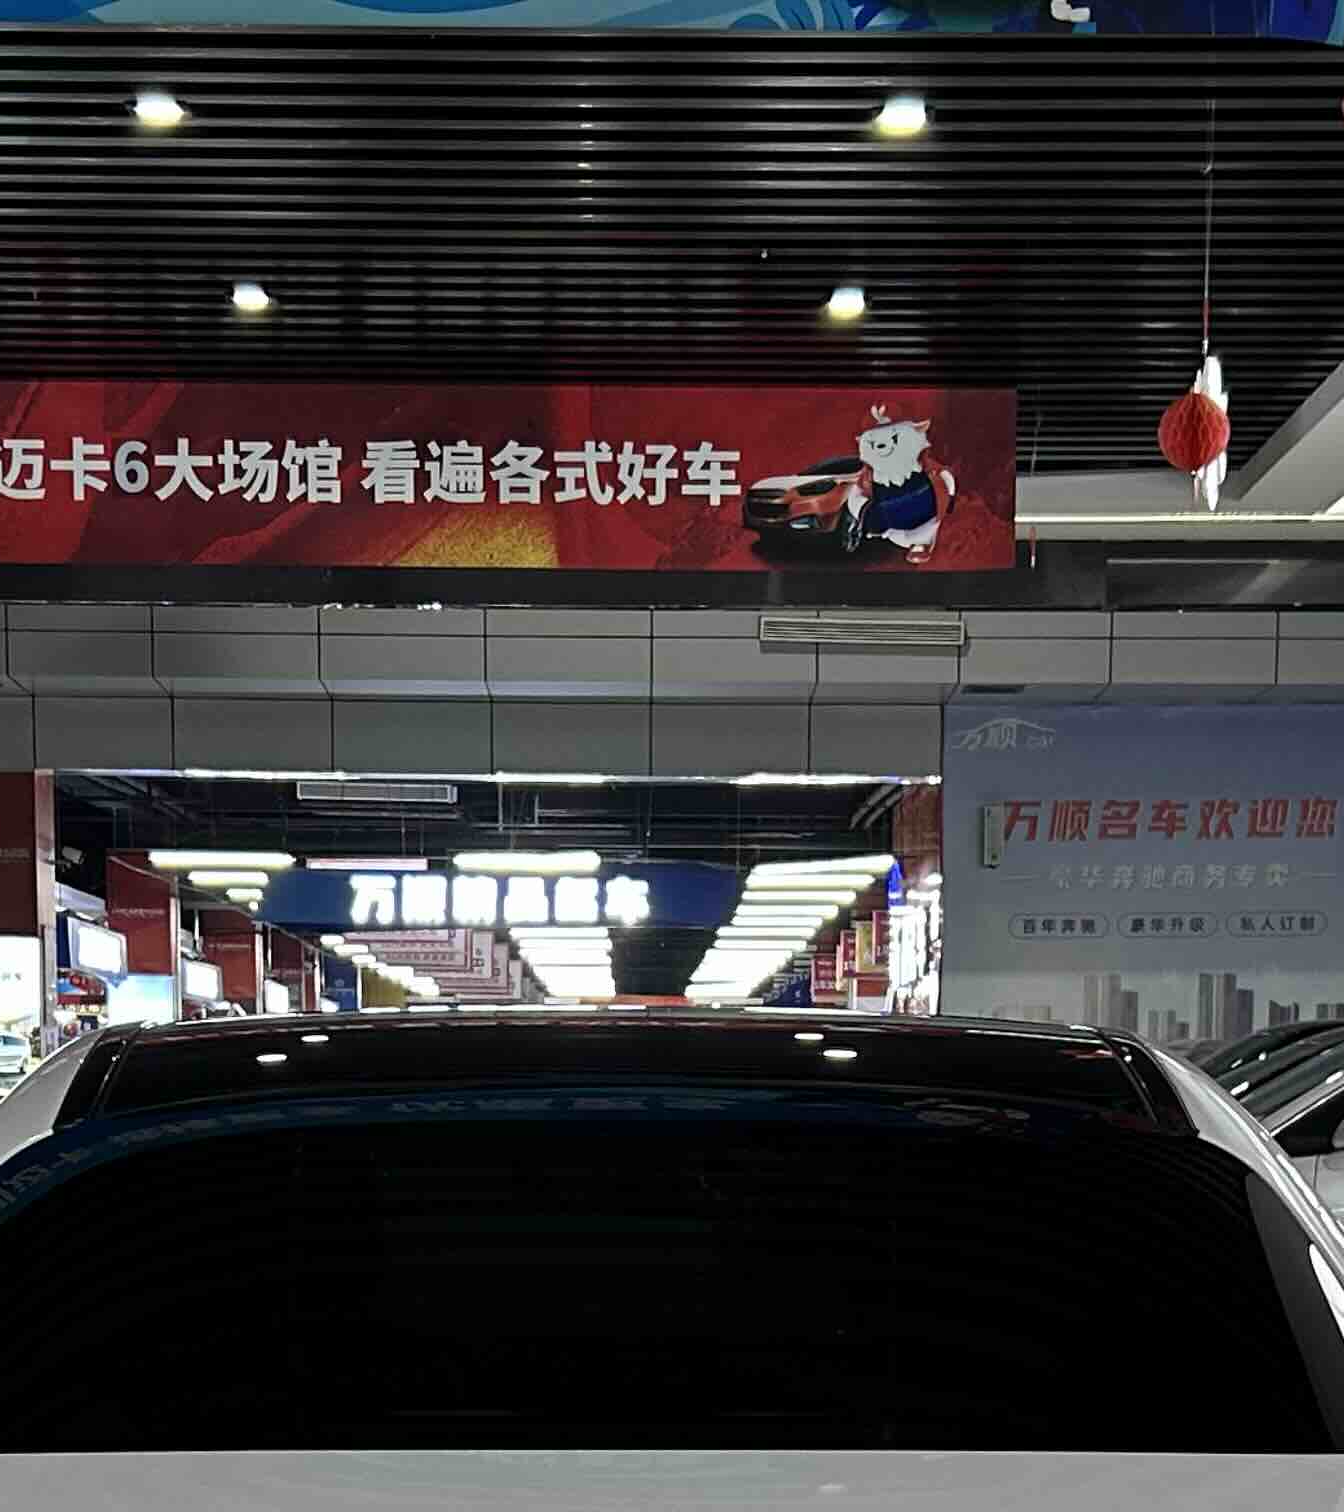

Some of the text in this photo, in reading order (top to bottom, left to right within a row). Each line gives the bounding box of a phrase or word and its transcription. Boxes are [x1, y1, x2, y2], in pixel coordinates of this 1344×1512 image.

[360, 440, 743, 508] 看遍各式好车
[1003, 800, 1341, 842] 万顺名车欢迎您
